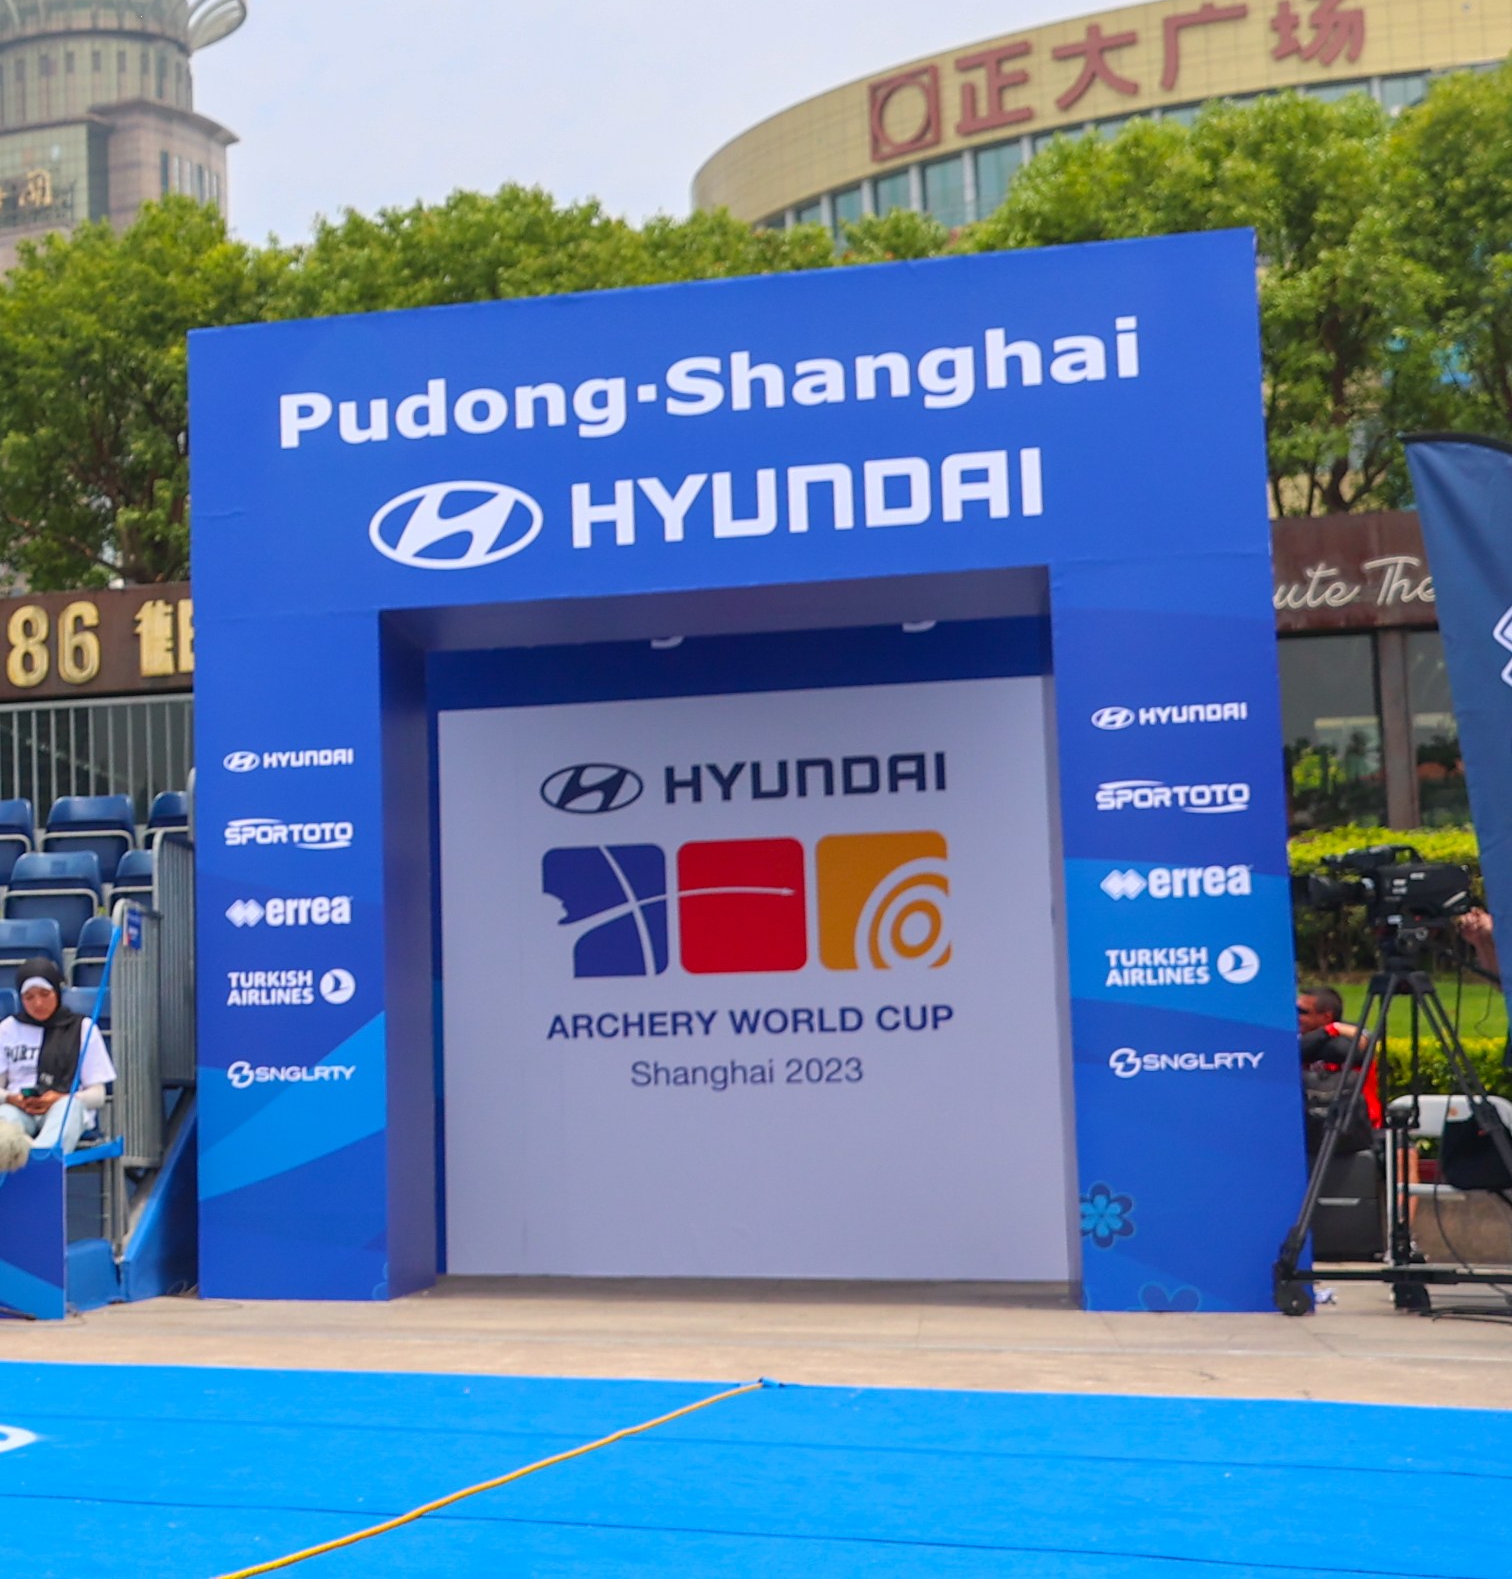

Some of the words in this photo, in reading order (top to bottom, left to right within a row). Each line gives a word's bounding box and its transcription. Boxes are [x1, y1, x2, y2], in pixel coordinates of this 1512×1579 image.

[571, 448, 1042, 549] HYUNDAI
[1139, 702, 1247, 725] HYUNDAI
[263, 748, 354, 769] HYUNDAI
[665, 751, 947, 804] HYUNDAI
[1095, 782, 1250, 812] SPORTOTO
[224, 820, 353, 848] SPORTOTO
[1148, 864, 1252, 898] errea
[265, 896, 351, 927] errea
[1105, 947, 1208, 968] TURKISH
[227, 970, 313, 988] TURKISH
[1105, 966, 1211, 987] AIRLINES
[226, 987, 314, 1006] AIRLINES
[546, 1009, 718, 1040] ARCHERY
[729, 1006, 864, 1036] WORLD
[875, 1004, 954, 1032] CUP
[254, 1065, 356, 1082] SNGLRTY
[630, 1059, 775, 1091] Shanghai
[785, 1057, 864, 1085] 2023
[1142, 1051, 1264, 1072] SNGLRTY
